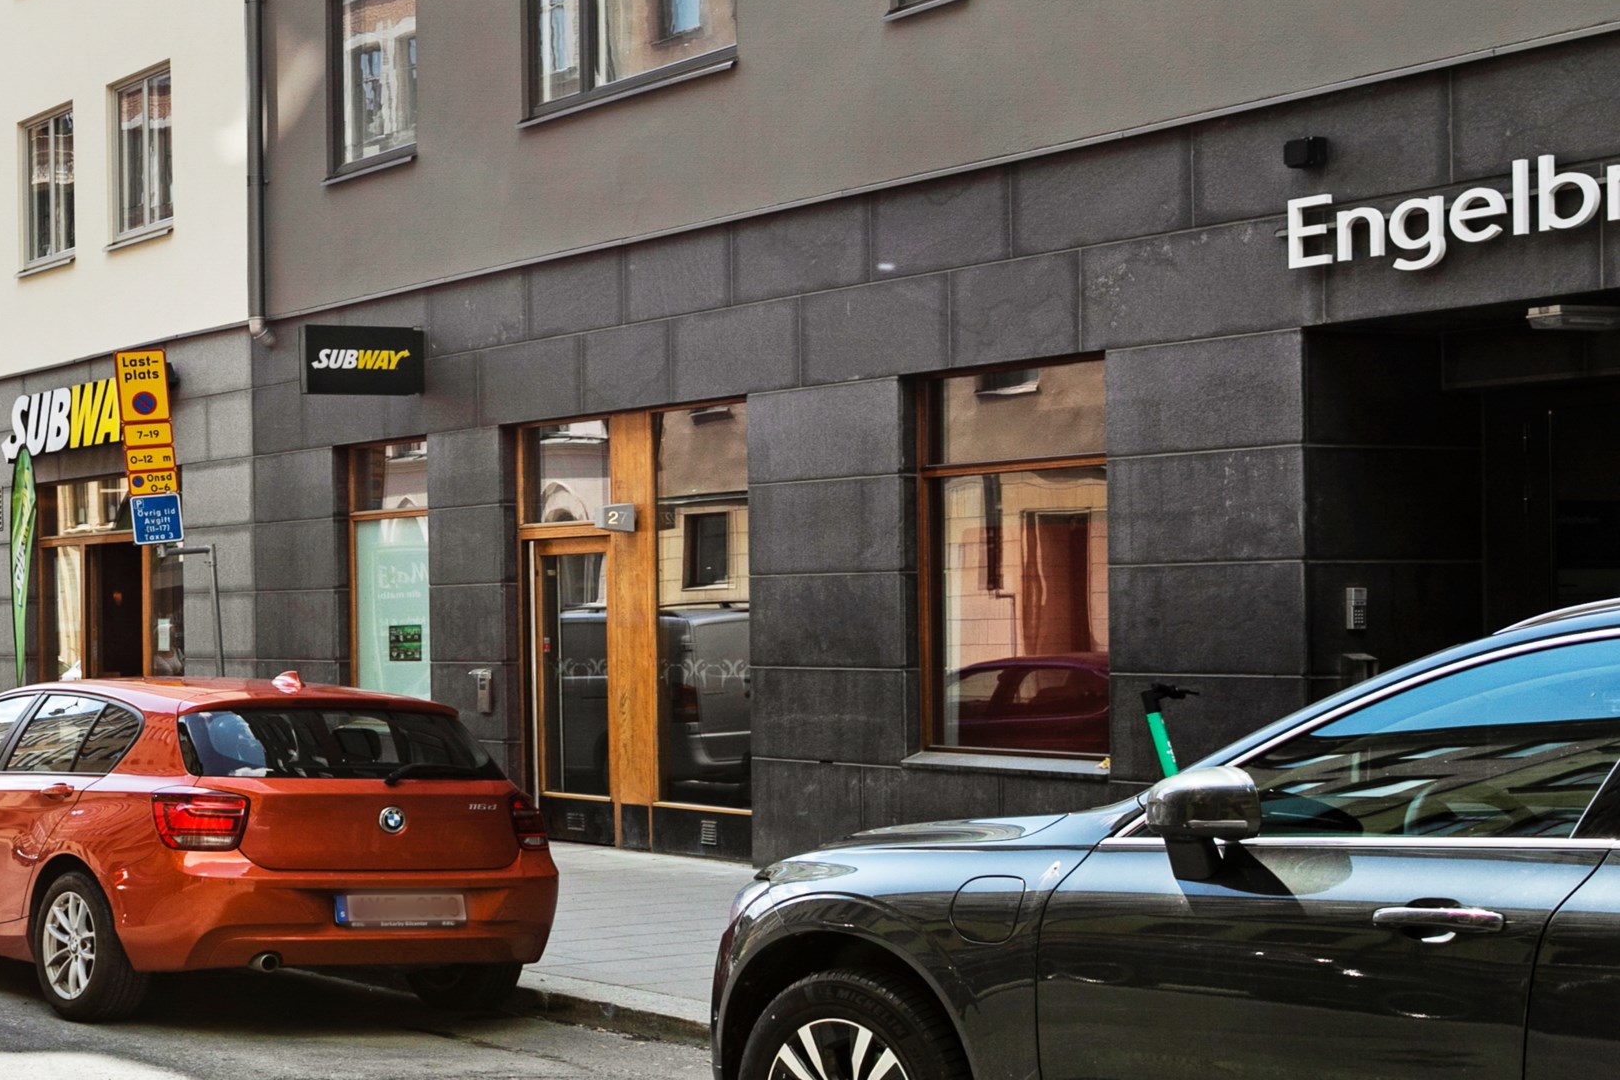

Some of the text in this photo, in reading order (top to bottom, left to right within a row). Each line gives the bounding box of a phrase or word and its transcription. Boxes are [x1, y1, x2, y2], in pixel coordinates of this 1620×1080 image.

[122, 356, 159, 367] Last-
[311, 348, 410, 370] SUBWAY
[124, 369, 160, 383] plats
[1, 377, 120, 463] SUBWA
[137, 430, 160, 439] 7-19
[130, 454, 153, 464] 0-12
[146, 473, 172, 483] Onsd
[150, 484, 171, 492] 0-6
[144, 517, 171, 525] Avgift
[608, 510, 628, 525] 27
[146, 524, 170, 533] (11-17)
